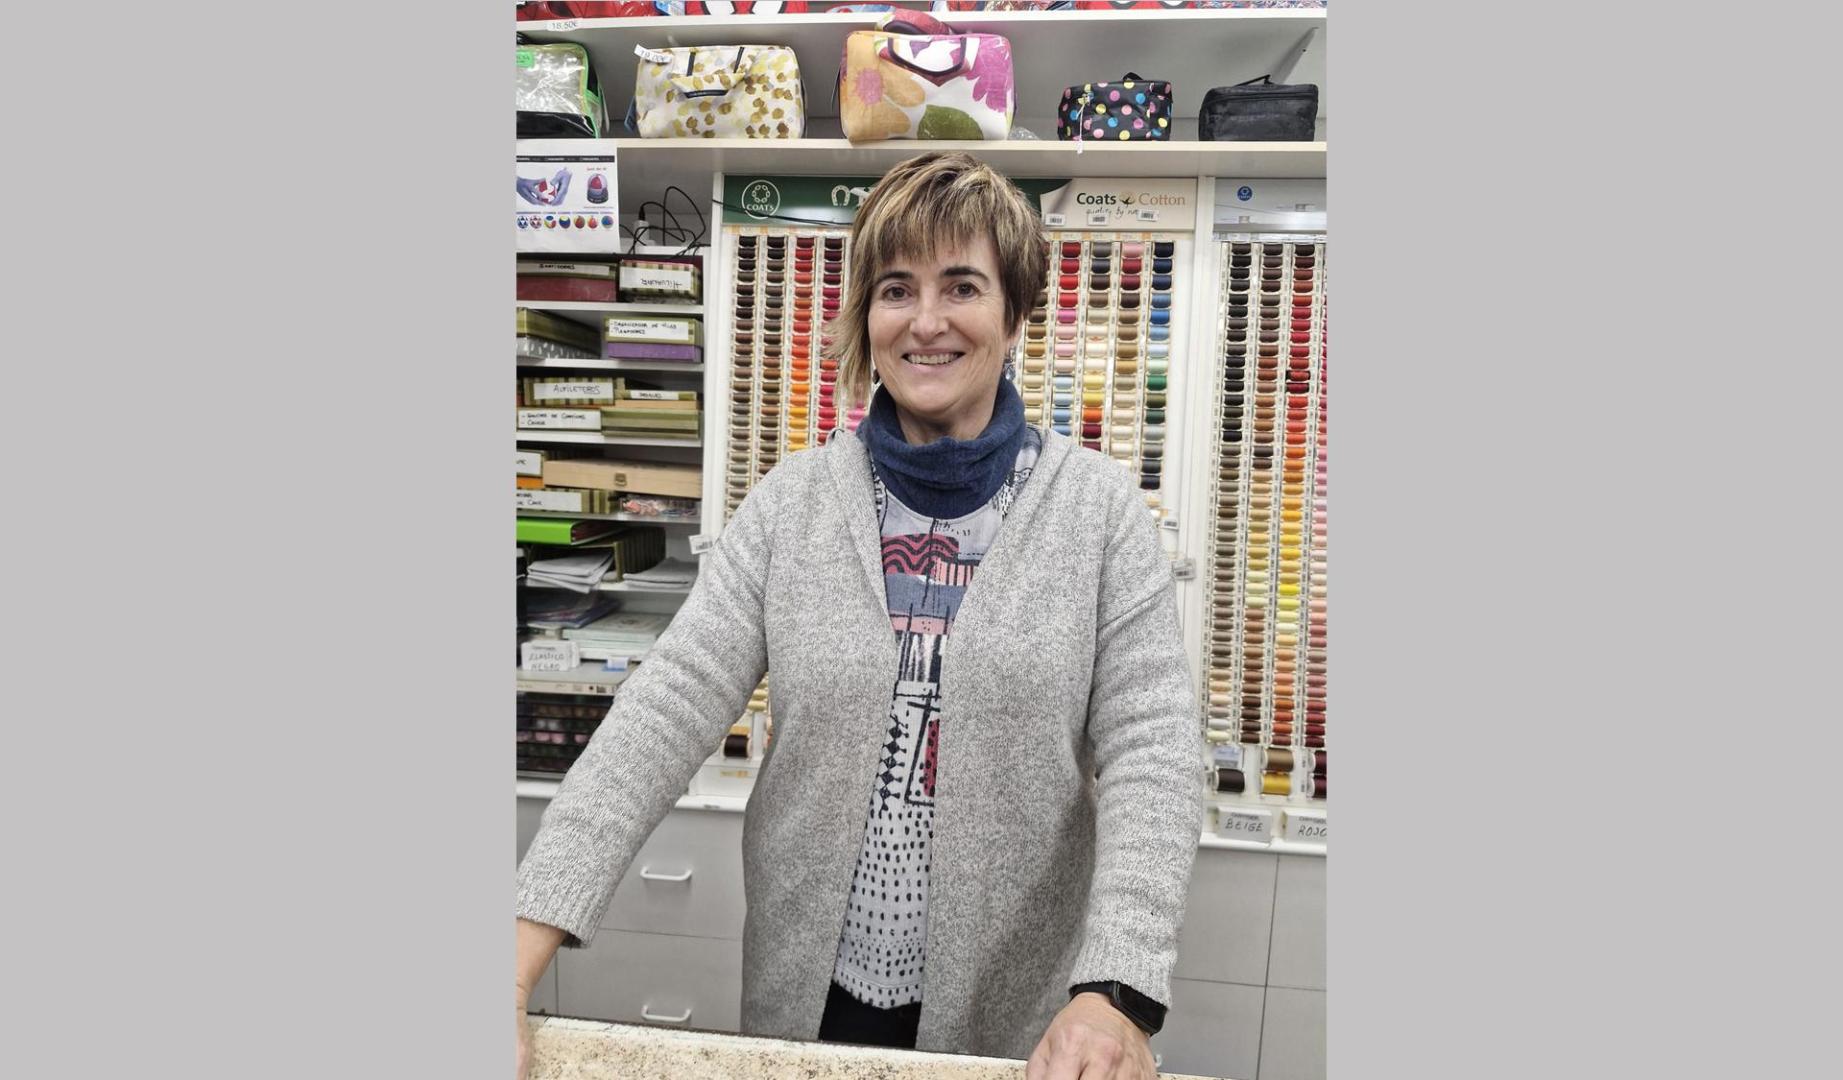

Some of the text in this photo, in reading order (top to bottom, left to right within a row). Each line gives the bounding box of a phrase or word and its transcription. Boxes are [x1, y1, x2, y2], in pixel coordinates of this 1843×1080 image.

[1076, 192, 1186, 206] Coats Cotton
[746, 203, 775, 212] COATS
[1225, 818, 1264, 832] BEIGE
